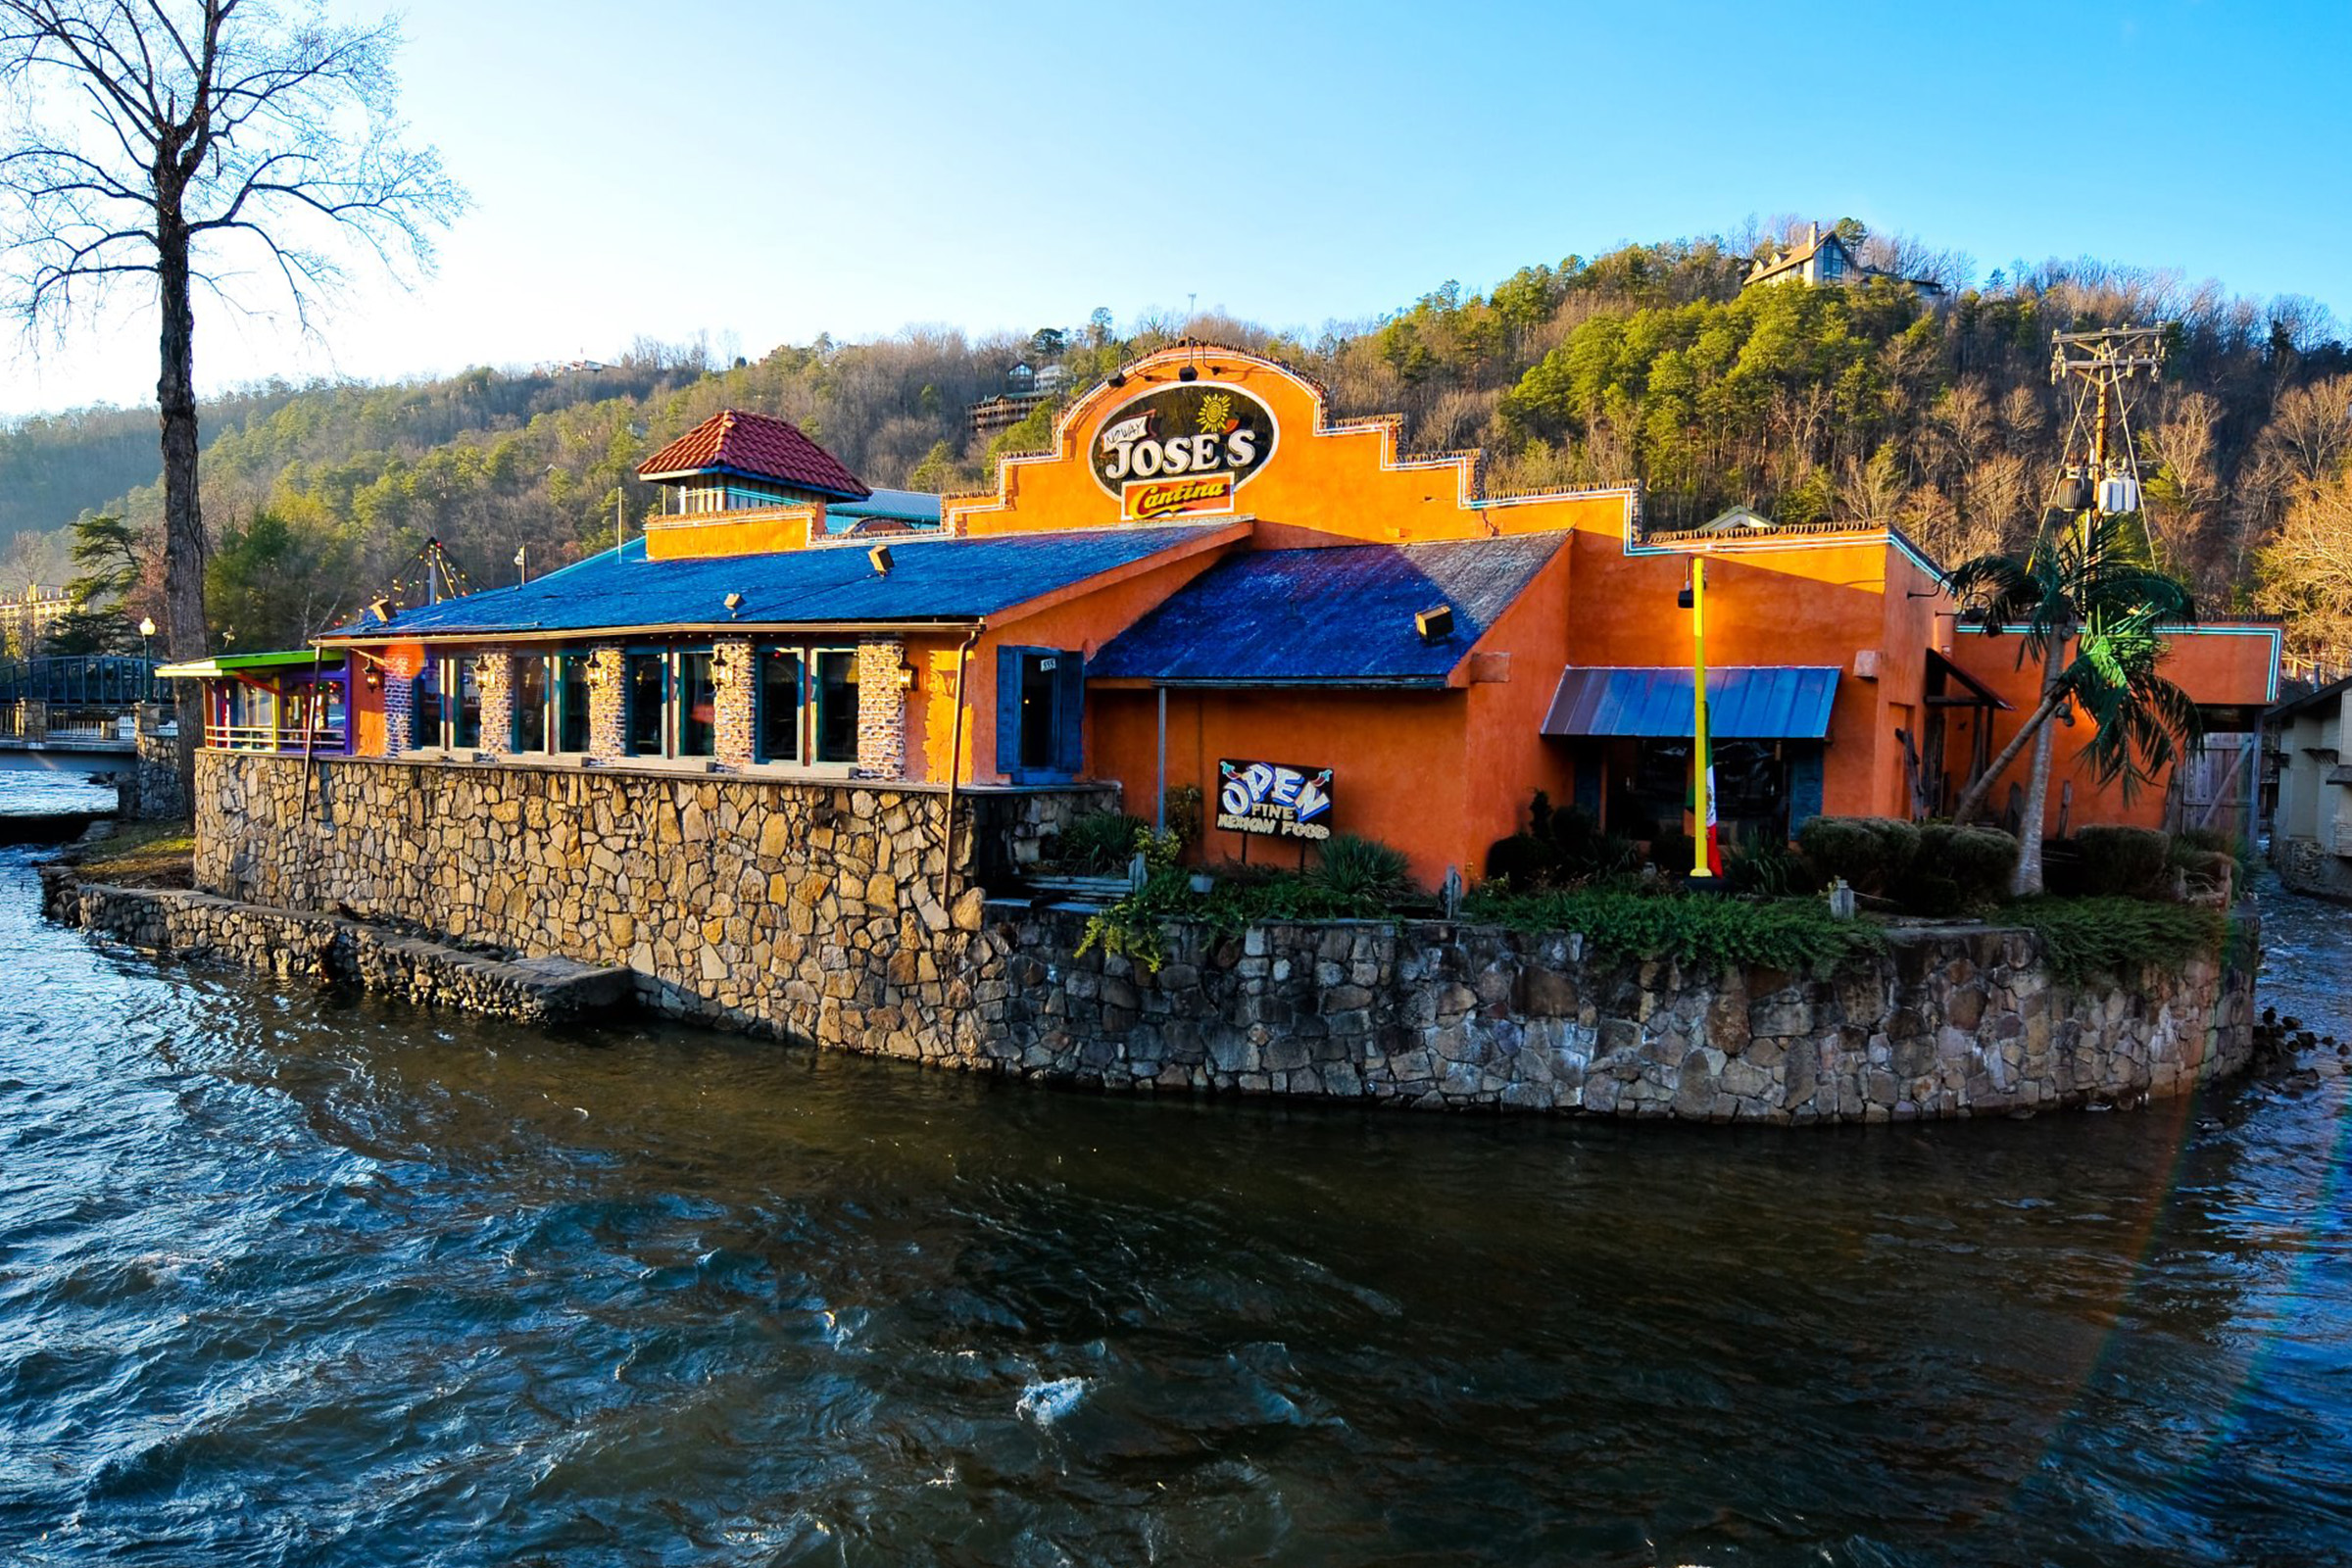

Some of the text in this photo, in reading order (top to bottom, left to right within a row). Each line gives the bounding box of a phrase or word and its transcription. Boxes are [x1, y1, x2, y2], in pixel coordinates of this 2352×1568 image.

[1128, 479, 1225, 519] Cantina
[1222, 762, 1331, 820] OPEN
[1250, 803, 1296, 820] FINE
[1281, 819, 1330, 840] FOOD
